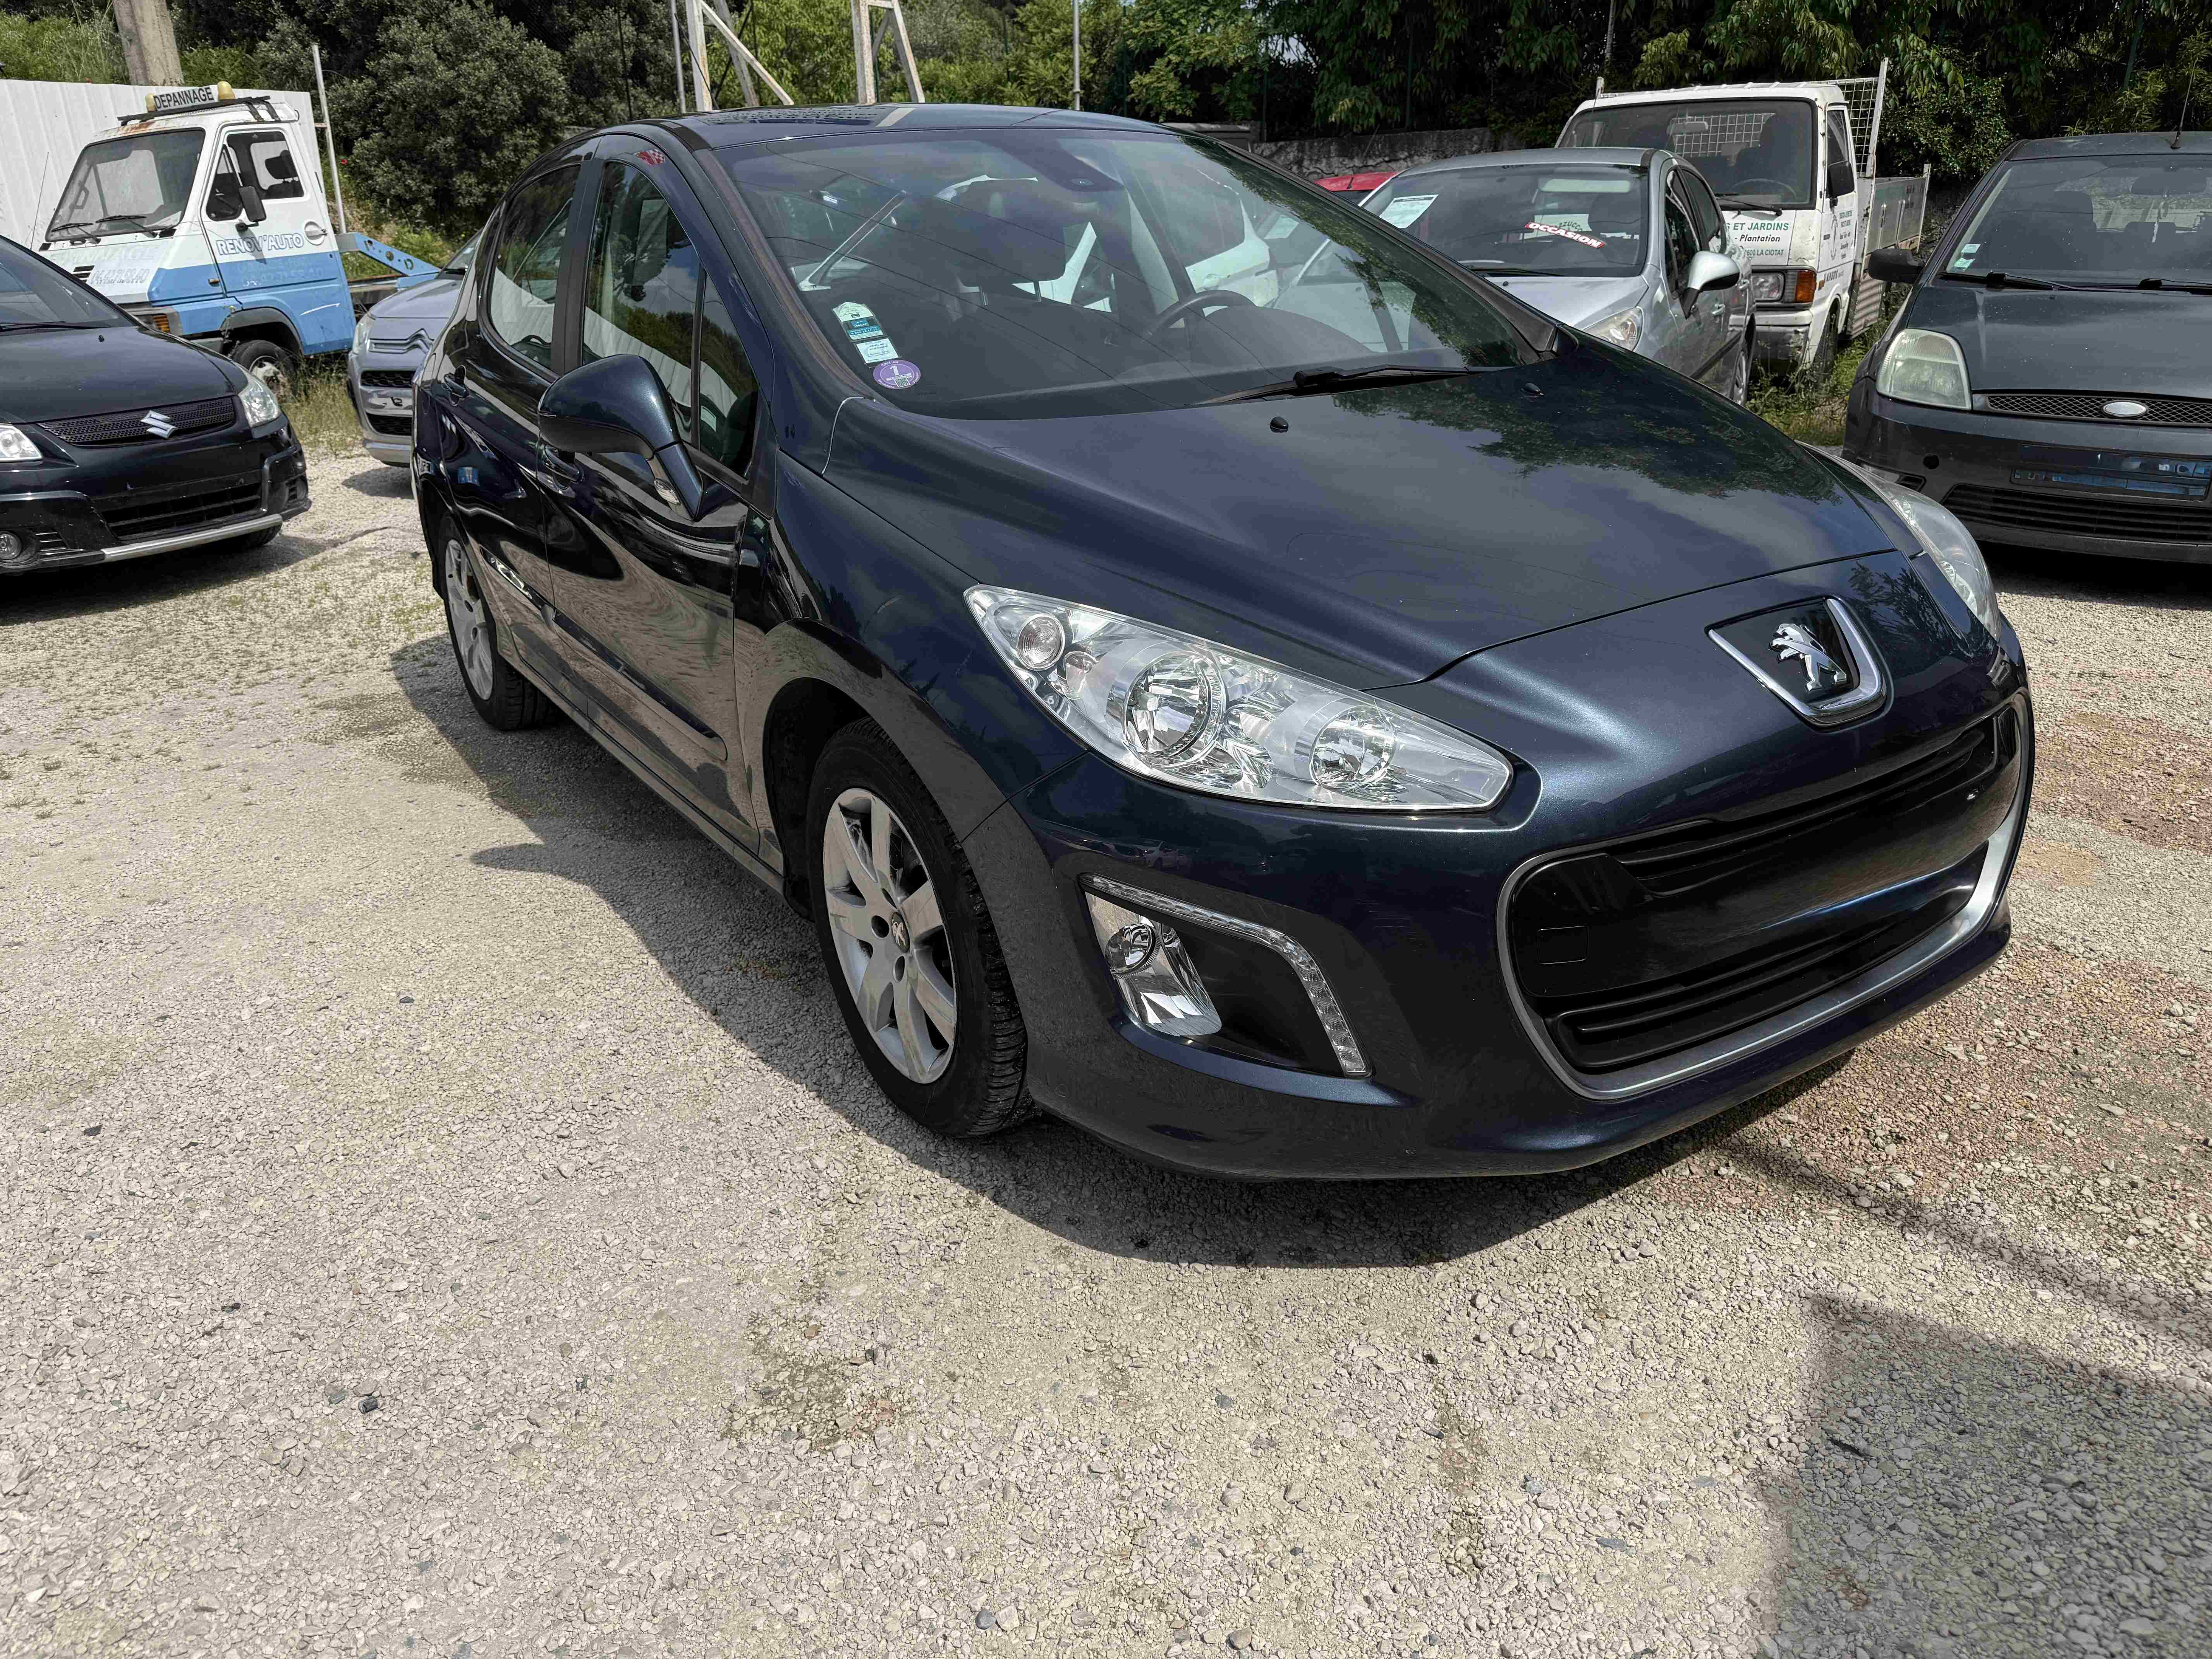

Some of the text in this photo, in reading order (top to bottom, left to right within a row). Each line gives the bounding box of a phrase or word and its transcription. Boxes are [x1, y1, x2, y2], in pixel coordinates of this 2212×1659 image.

[153, 86, 214, 109] DEPANNAGE
[1528, 222, 1601, 248] OCCASION
[1555, 221, 1583, 232] ZZUCCO
[216, 232, 304, 256] RENOV'AUTO
